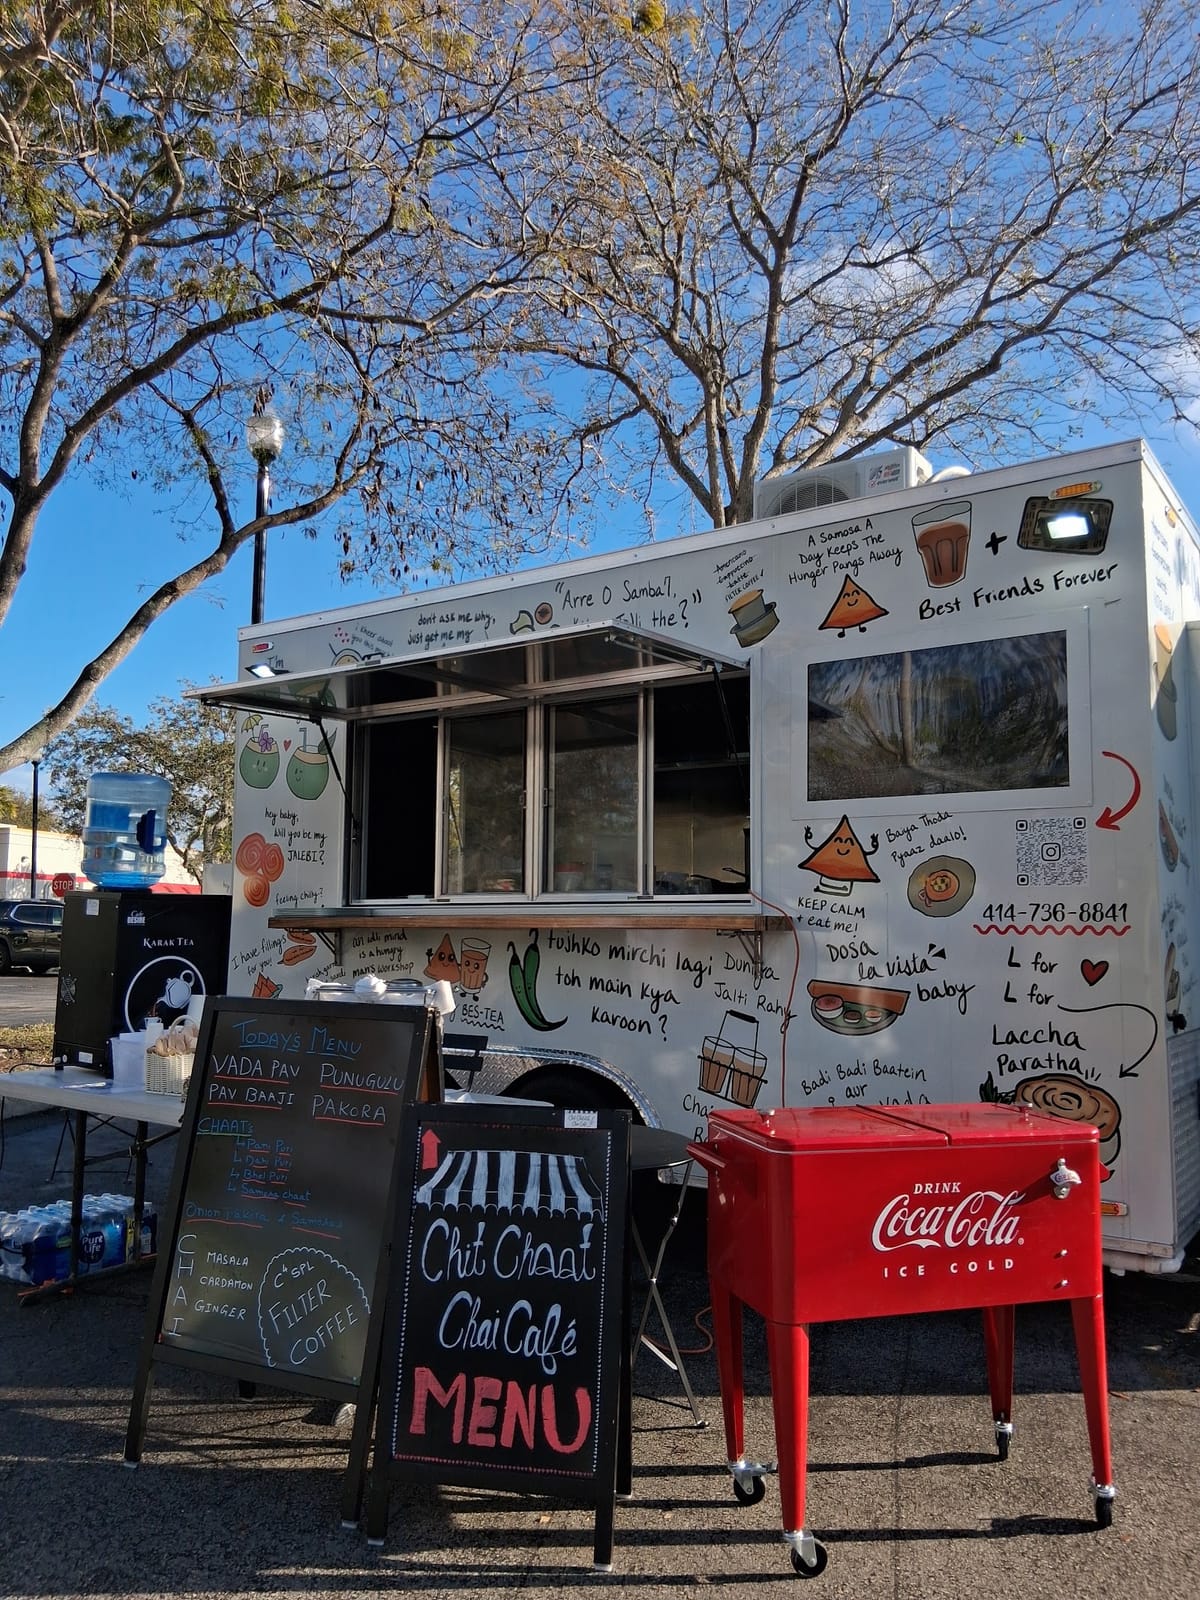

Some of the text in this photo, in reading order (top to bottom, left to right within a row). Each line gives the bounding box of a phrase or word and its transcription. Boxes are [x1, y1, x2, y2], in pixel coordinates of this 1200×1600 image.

[808, 518, 873, 547] A Samosa A
[799, 534, 885, 567] Day Keeps The
[789, 547, 903, 588] Hunger Pangs Away
[602, 586, 612, 604] O
[919, 563, 1118, 620] Best Friends Forever
[439, 612, 455, 623] ask
[458, 612, 472, 622] me
[474, 610, 496, 630] why,
[407, 629, 474, 650] just get me my
[265, 808, 277, 826] hey
[919, 811, 953, 826] Thoda
[288, 830, 301, 846] you
[303, 828, 312, 839] be
[314, 832, 327, 848] my
[891, 825, 967, 868] Pyaaz daalo!
[53, 880, 73, 890] STOP
[798, 896, 866, 919] KEEP CALM
[982, 903, 1128, 923] 414-736-8841
[384, 928, 407, 943] mind
[807, 914, 831, 929] eat
[834, 921, 858, 939] me!
[143, 937, 195, 949] KARAK TEA
[232, 934, 287, 970] I have fillings
[359, 950, 366, 959] is
[376, 946, 403, 961] hungry
[247, 964, 257, 976] for
[378, 961, 414, 975] workshop
[608, 944, 666, 968] mirchi
[676, 952, 713, 988] lagi
[858, 953, 937, 981] la vista
[1008, 946, 1058, 974] L for
[555, 966, 581, 988] toh
[589, 976, 632, 998] main
[714, 982, 748, 1005] Jalti
[1004, 981, 1054, 1006] L for
[917, 980, 976, 1015] baby
[462, 1003, 504, 1024] BES-TEA
[992, 1021, 1087, 1051] Laccha
[211, 1055, 300, 1078] VADA PAV
[997, 1052, 1084, 1077] Paratha
[320, 1063, 405, 1091] PUNUGULU
[801, 1059, 927, 1096] Badi Badi Baatein
[209, 1084, 295, 1105] PAV BAAJI
[845, 1083, 868, 1099] aur
[312, 1095, 386, 1122] PAKORA
[913, 1182, 962, 1195] DRINK
[872, 1190, 1026, 1252] Coca-Cola
[82, 1235, 103, 1246] Pure
[84, 1244, 101, 1255] Life
[421, 1218, 596, 1282] Chit Chaat
[207, 1251, 249, 1267] MASALA
[291, 1261, 315, 1279] SPL
[883, 1258, 1014, 1278] ICE COLD
[194, 1300, 248, 1320] GINGER
[268, 1279, 332, 1335] FILTER
[290, 1305, 359, 1365] COFFEE
[439, 1291, 577, 1375] Chai Café
[409, 1367, 592, 1454] MENU
